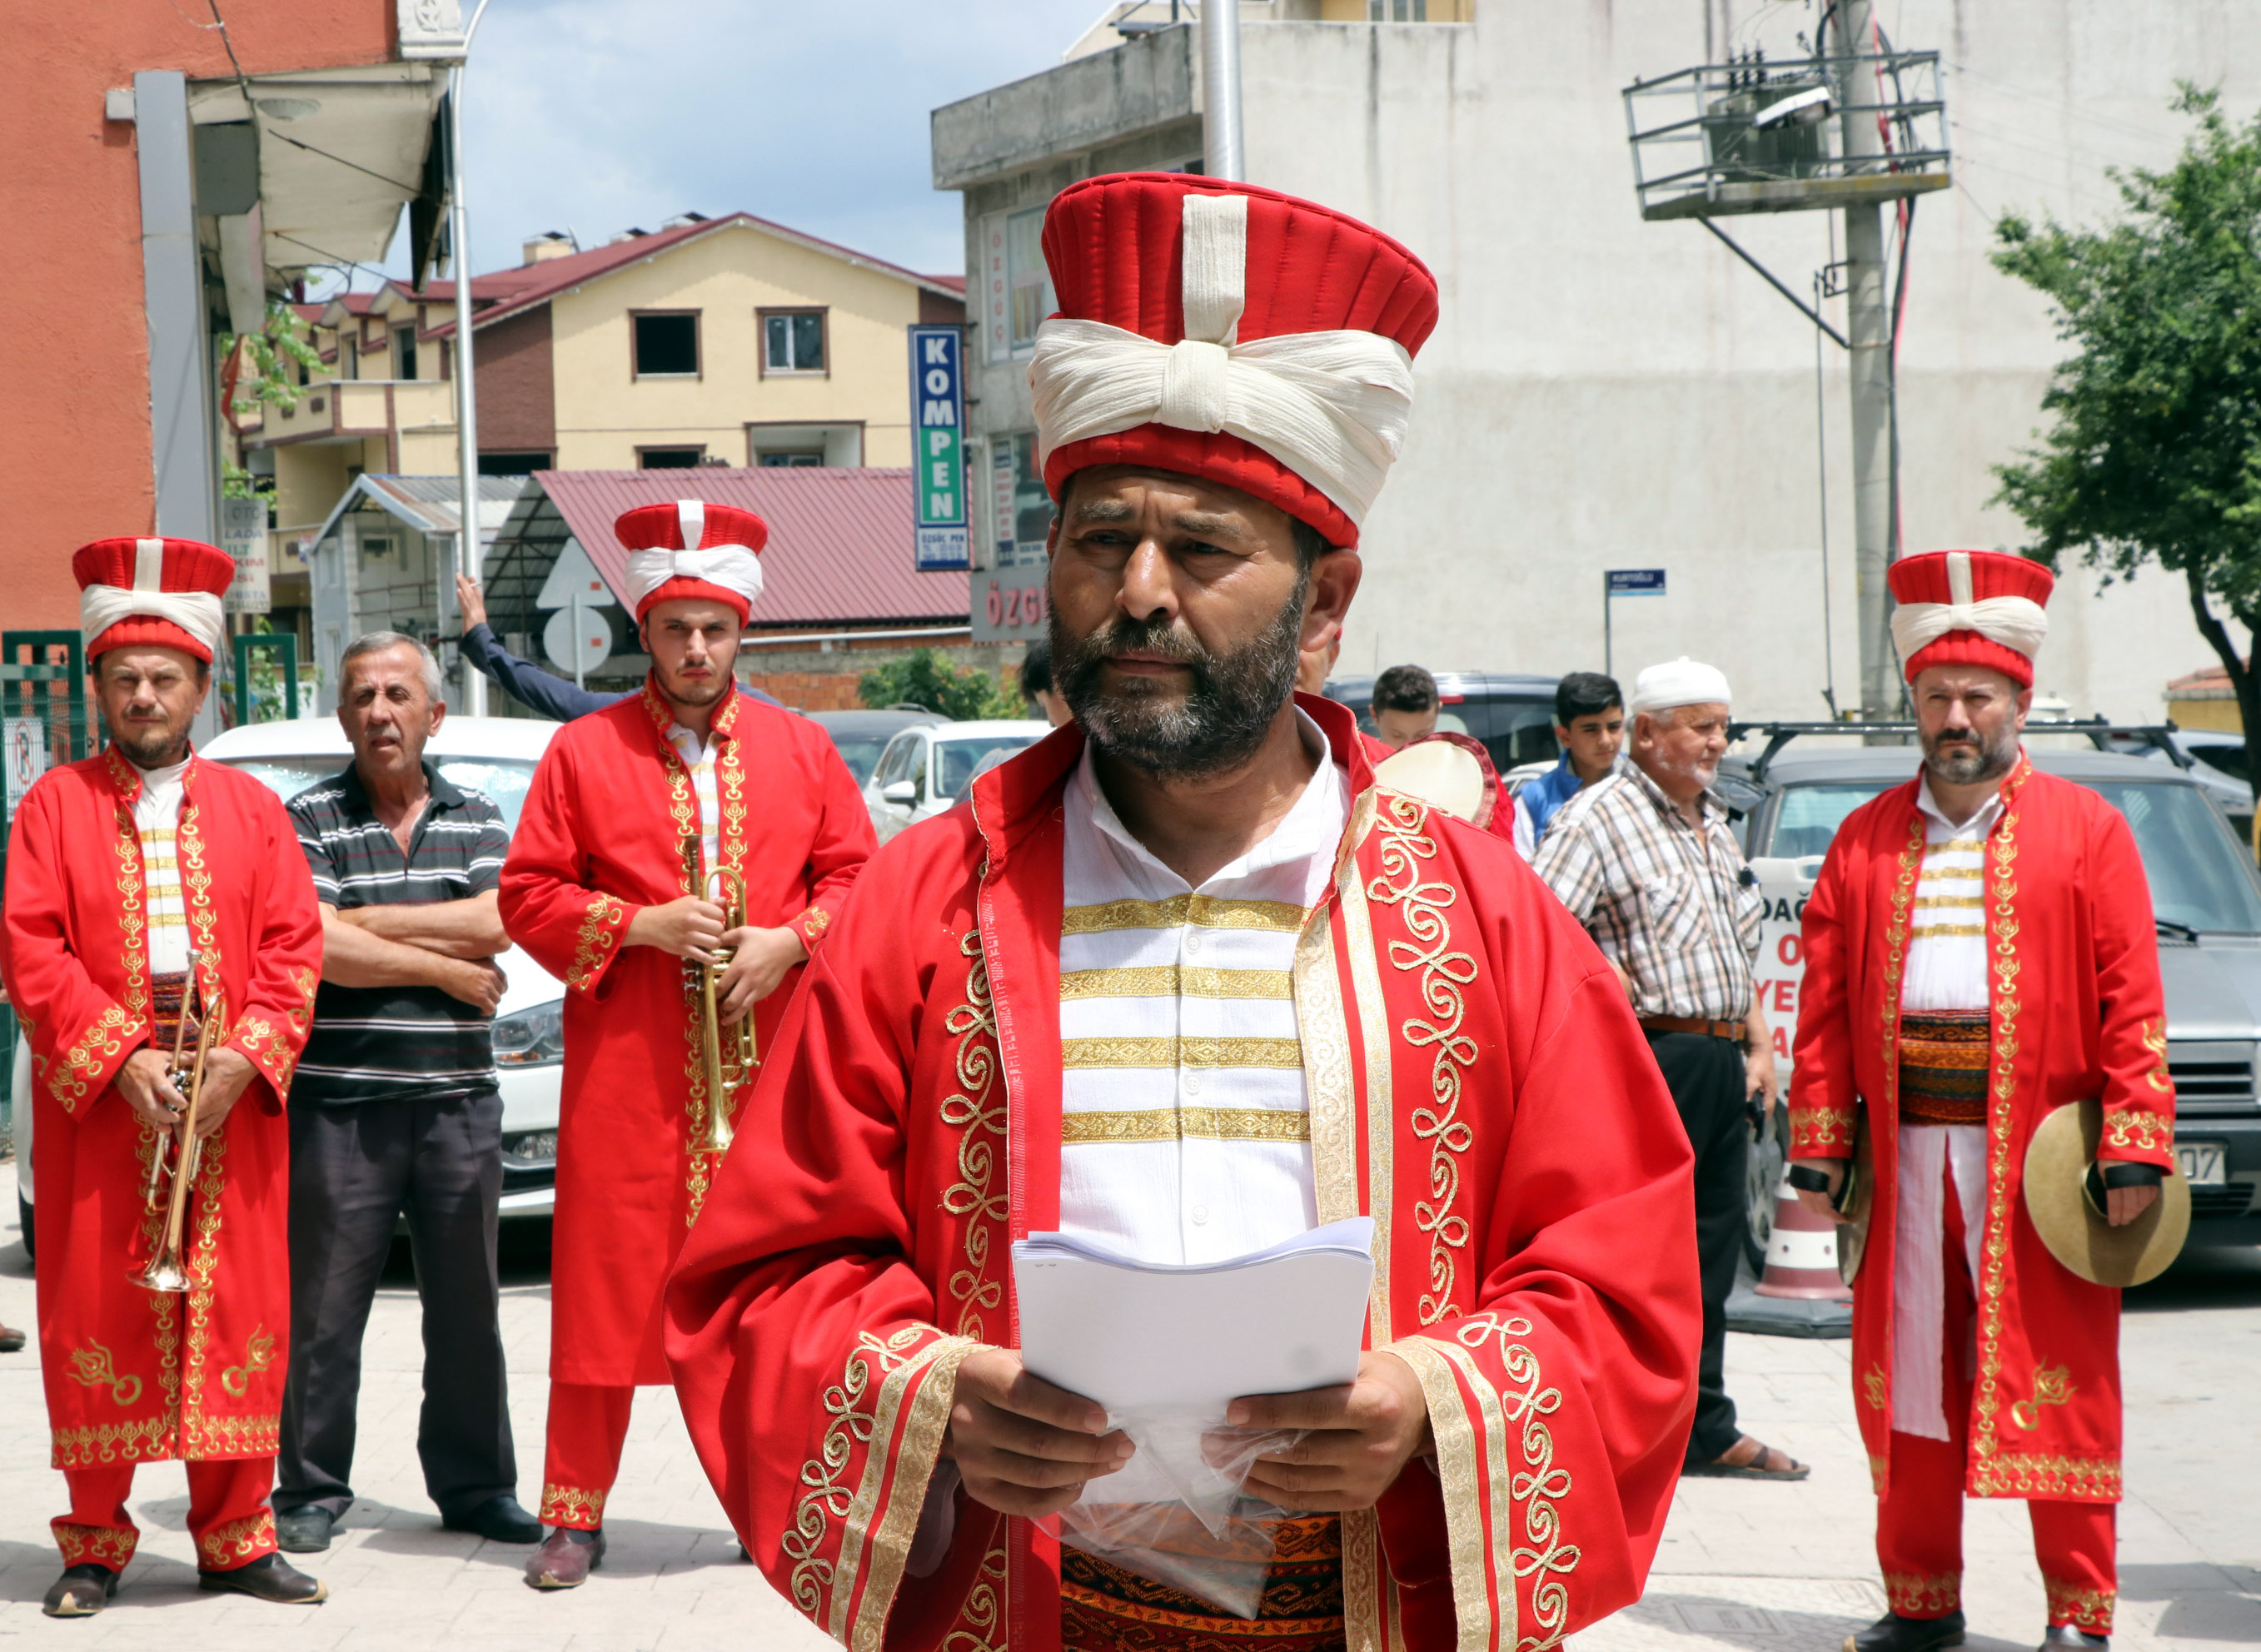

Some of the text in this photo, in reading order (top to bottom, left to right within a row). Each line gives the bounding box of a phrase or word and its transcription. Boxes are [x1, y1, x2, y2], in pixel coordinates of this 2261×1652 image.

[923, 337, 956, 520] KOMPEN
[224, 530, 263, 540] LADA
[2180, 1148, 2219, 1179] 07
